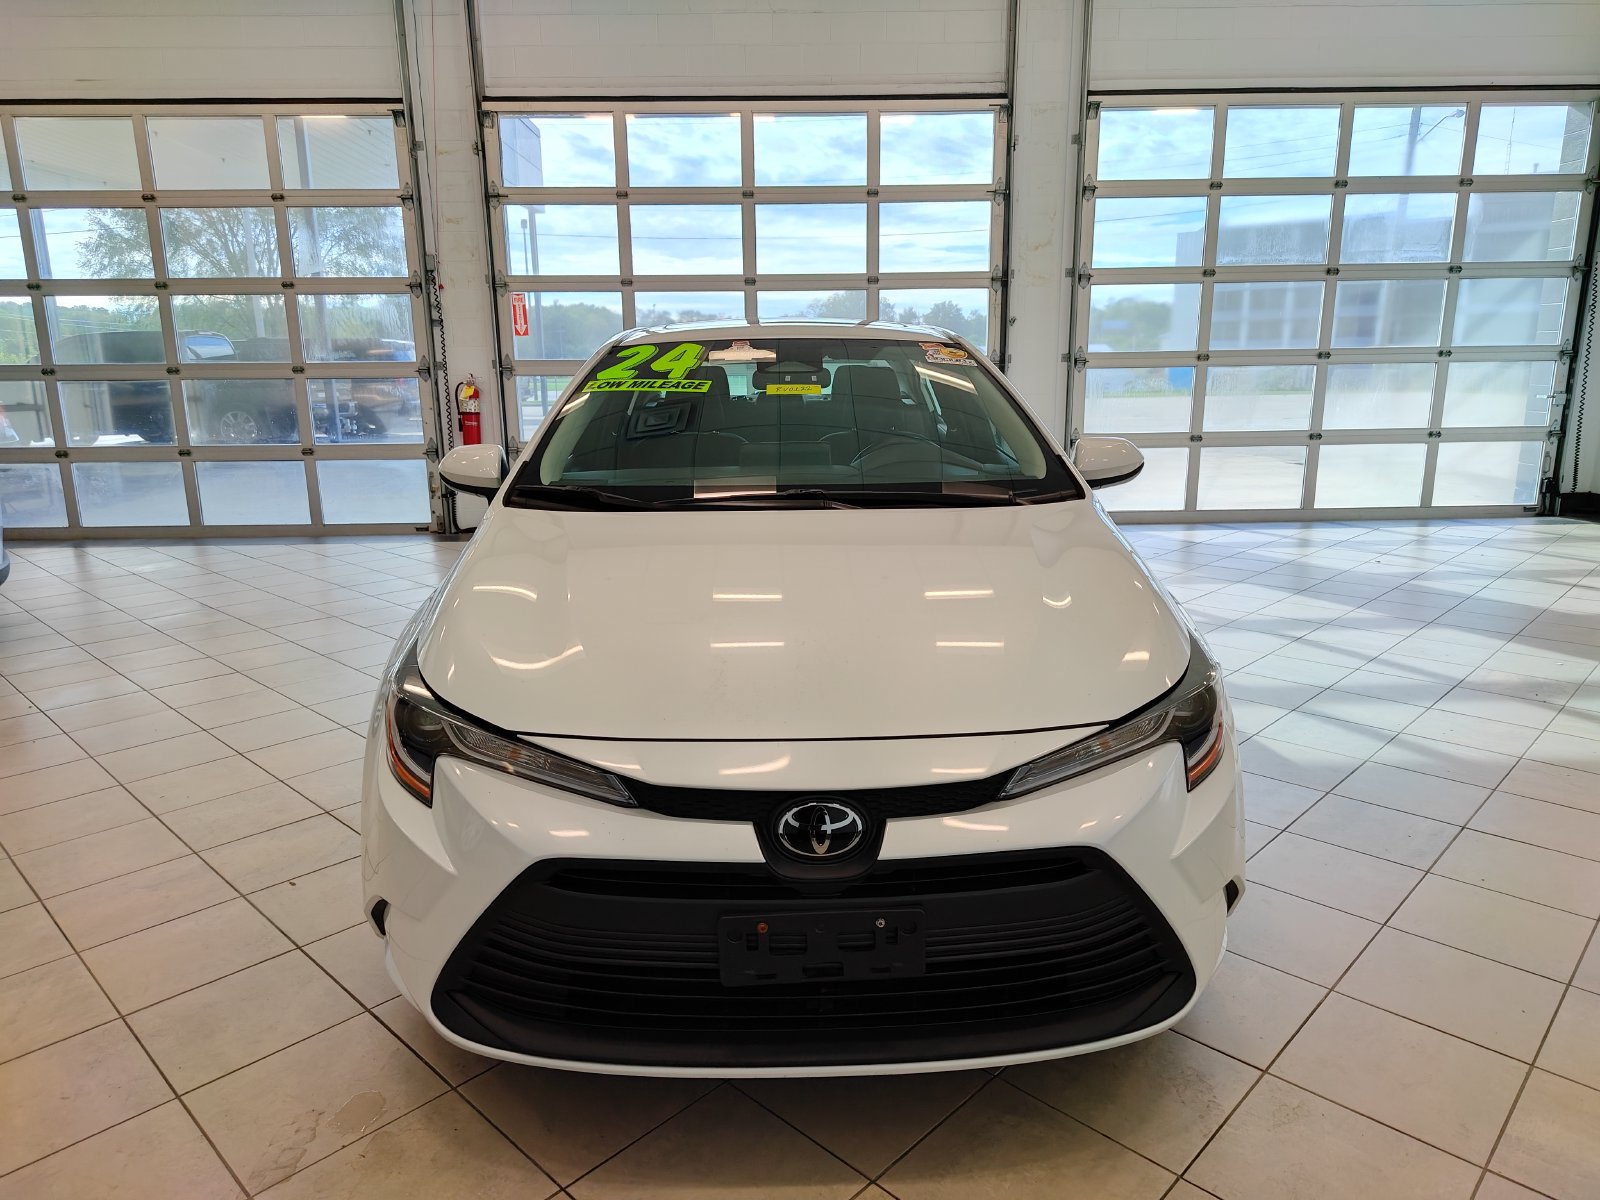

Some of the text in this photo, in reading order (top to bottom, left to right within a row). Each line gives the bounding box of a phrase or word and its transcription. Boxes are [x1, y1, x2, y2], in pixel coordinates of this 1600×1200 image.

[597, 343, 705, 380] 24
[587, 380, 706, 390] LOW MILEAGE
